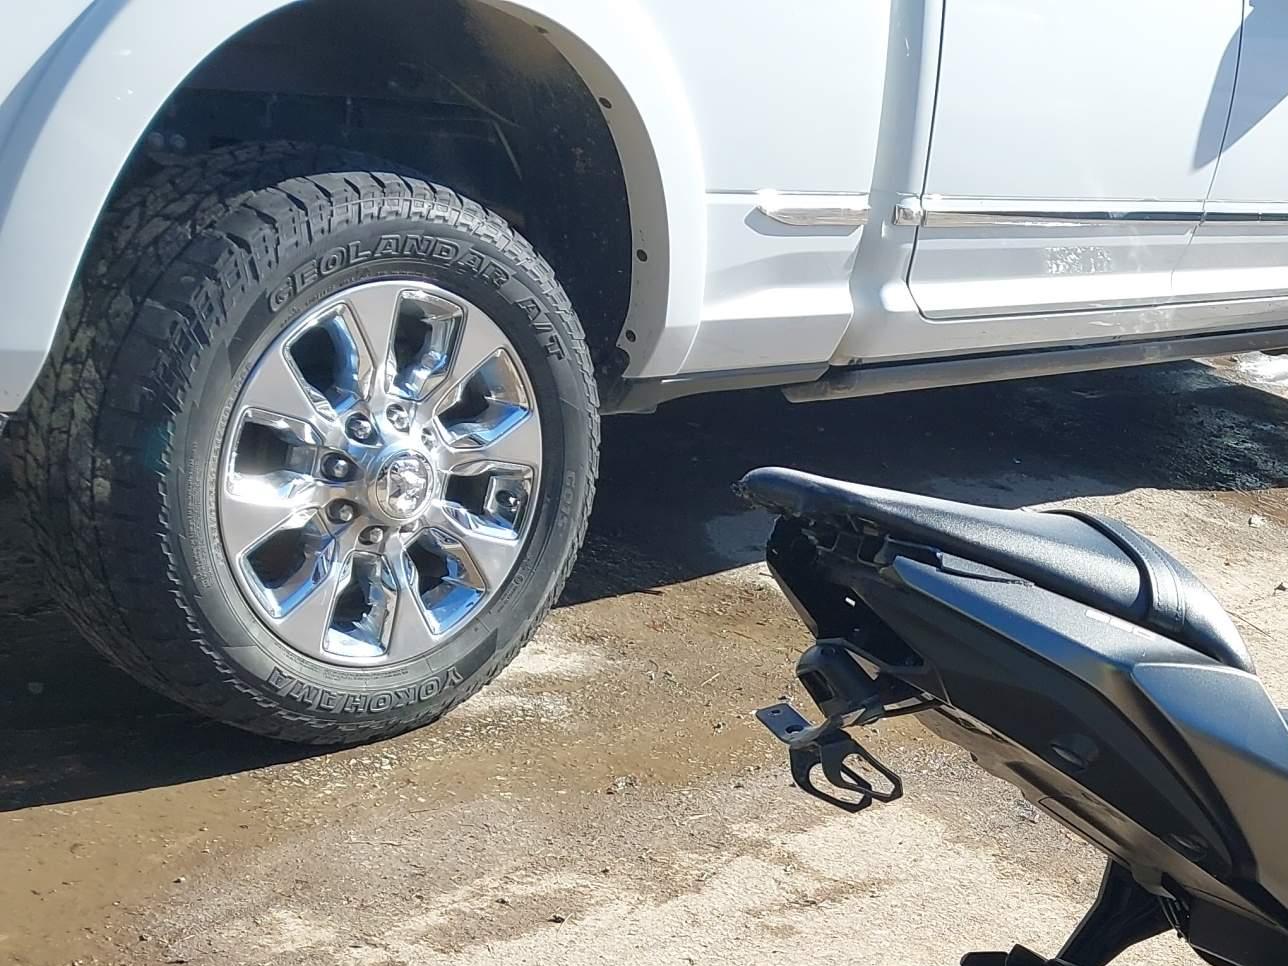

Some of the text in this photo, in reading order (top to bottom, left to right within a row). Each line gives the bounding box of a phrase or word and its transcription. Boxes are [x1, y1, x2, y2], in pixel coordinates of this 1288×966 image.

[268, 234, 512, 313] GEOLANDAR
[515, 297, 569, 361] A/T
[268, 666, 463, 714] YOKOHAMA
